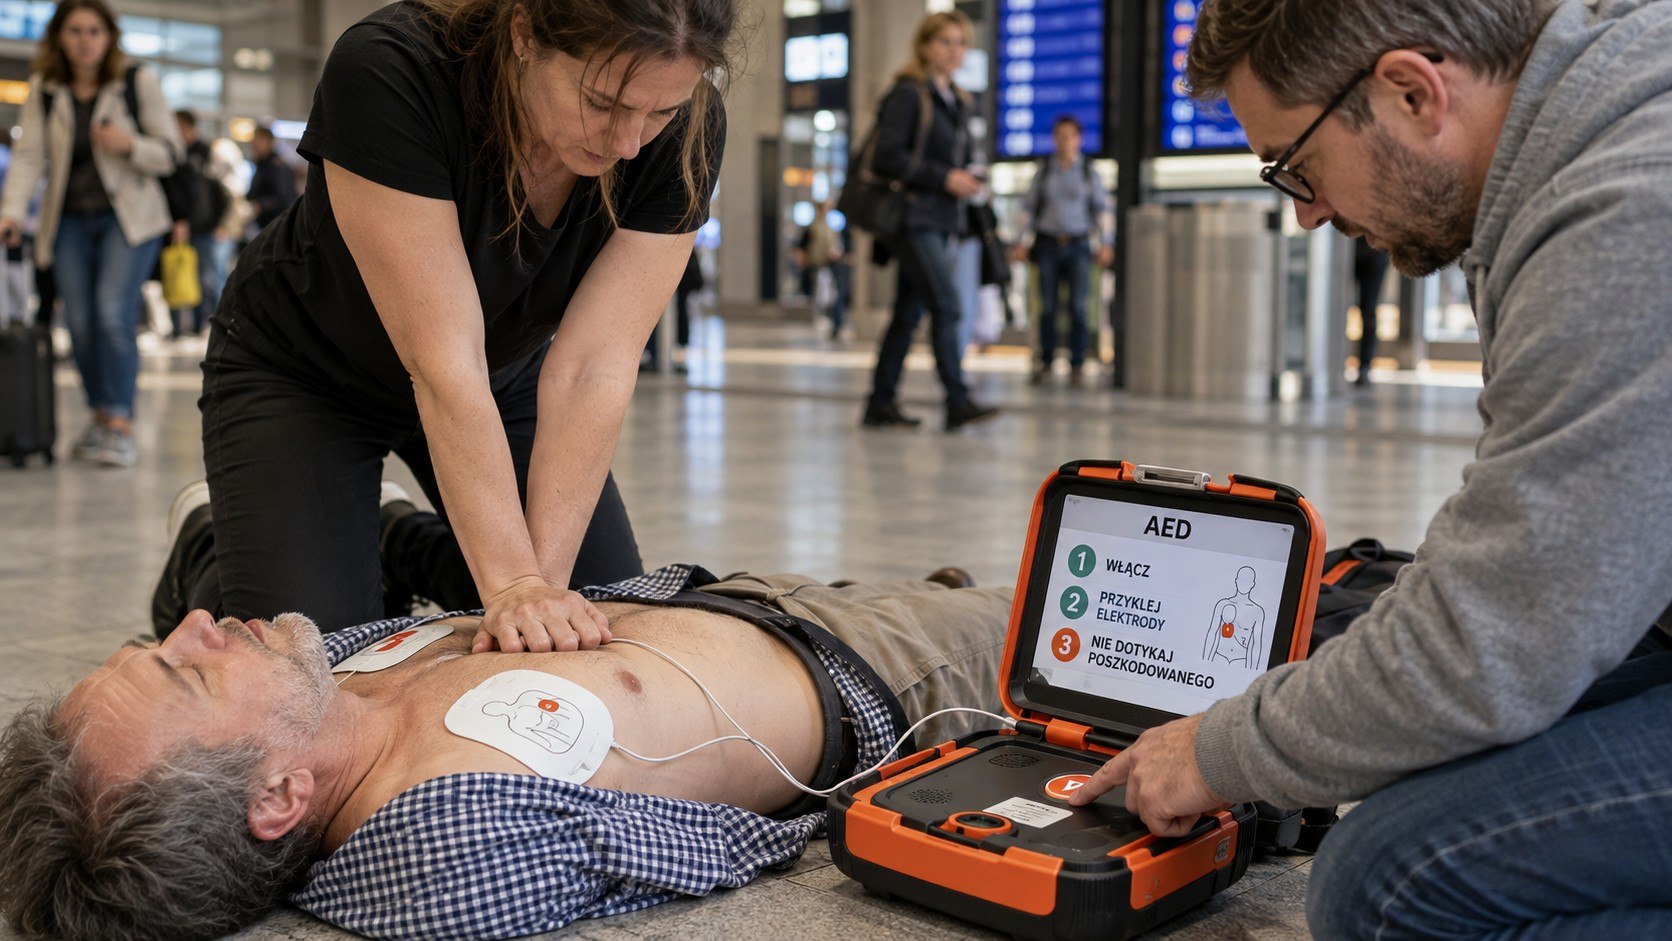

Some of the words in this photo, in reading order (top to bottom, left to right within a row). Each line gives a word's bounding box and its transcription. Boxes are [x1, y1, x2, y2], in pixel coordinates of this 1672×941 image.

[1143, 515, 1192, 540] AED
[1077, 551, 1087, 571] 1
[1106, 558, 1151, 578] WŁĄCZ
[1066, 592, 1081, 613] 2
[1099, 591, 1162, 614] PRZYKLEJ
[1096, 607, 1166, 631] ELEKTRODY
[1058, 634, 1073, 655] 3
[1091, 635, 1113, 650] NIE
[1114, 640, 1174, 663] DOTYKAJ
[1087, 652, 1215, 689] POSZKODOWANEGO
